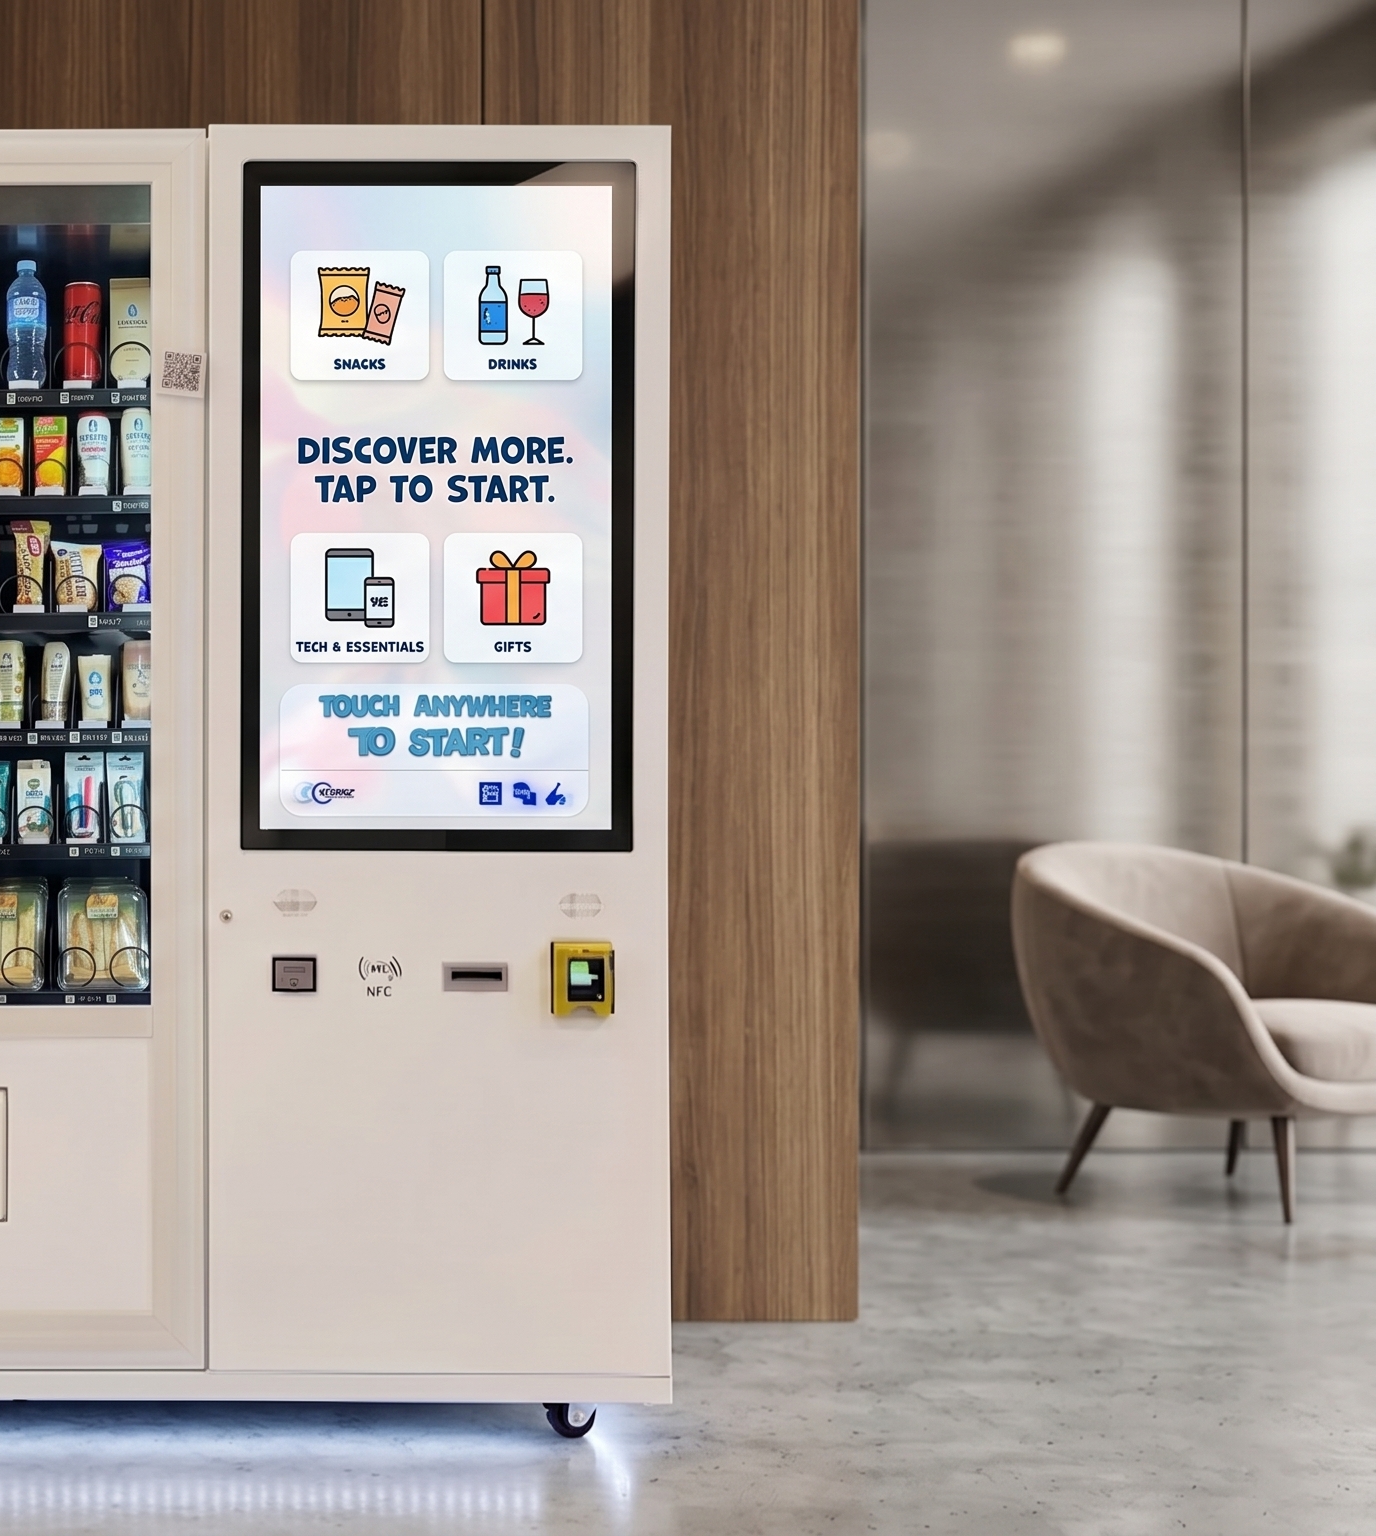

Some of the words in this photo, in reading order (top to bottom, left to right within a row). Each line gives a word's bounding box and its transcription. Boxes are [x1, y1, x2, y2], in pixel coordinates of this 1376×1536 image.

[333, 357, 386, 371] SNACKS
[488, 358, 538, 371] DRINKS
[297, 436, 458, 465] DISCOVER
[470, 436, 574, 465] MORE.
[314, 474, 377, 503] TAP
[389, 474, 434, 503] TO
[447, 474, 555, 503] START.
[295, 641, 328, 653] TECH
[332, 641, 341, 653] &
[346, 640, 425, 653] ESSENTIALS
[493, 641, 532, 653] GIFTS
[318, 694, 401, 719] TOUCH
[413, 694, 553, 719] ANYWHERE
[347, 726, 397, 757] TO
[407, 726, 526, 759] START!
[366, 985, 393, 998] NFC
